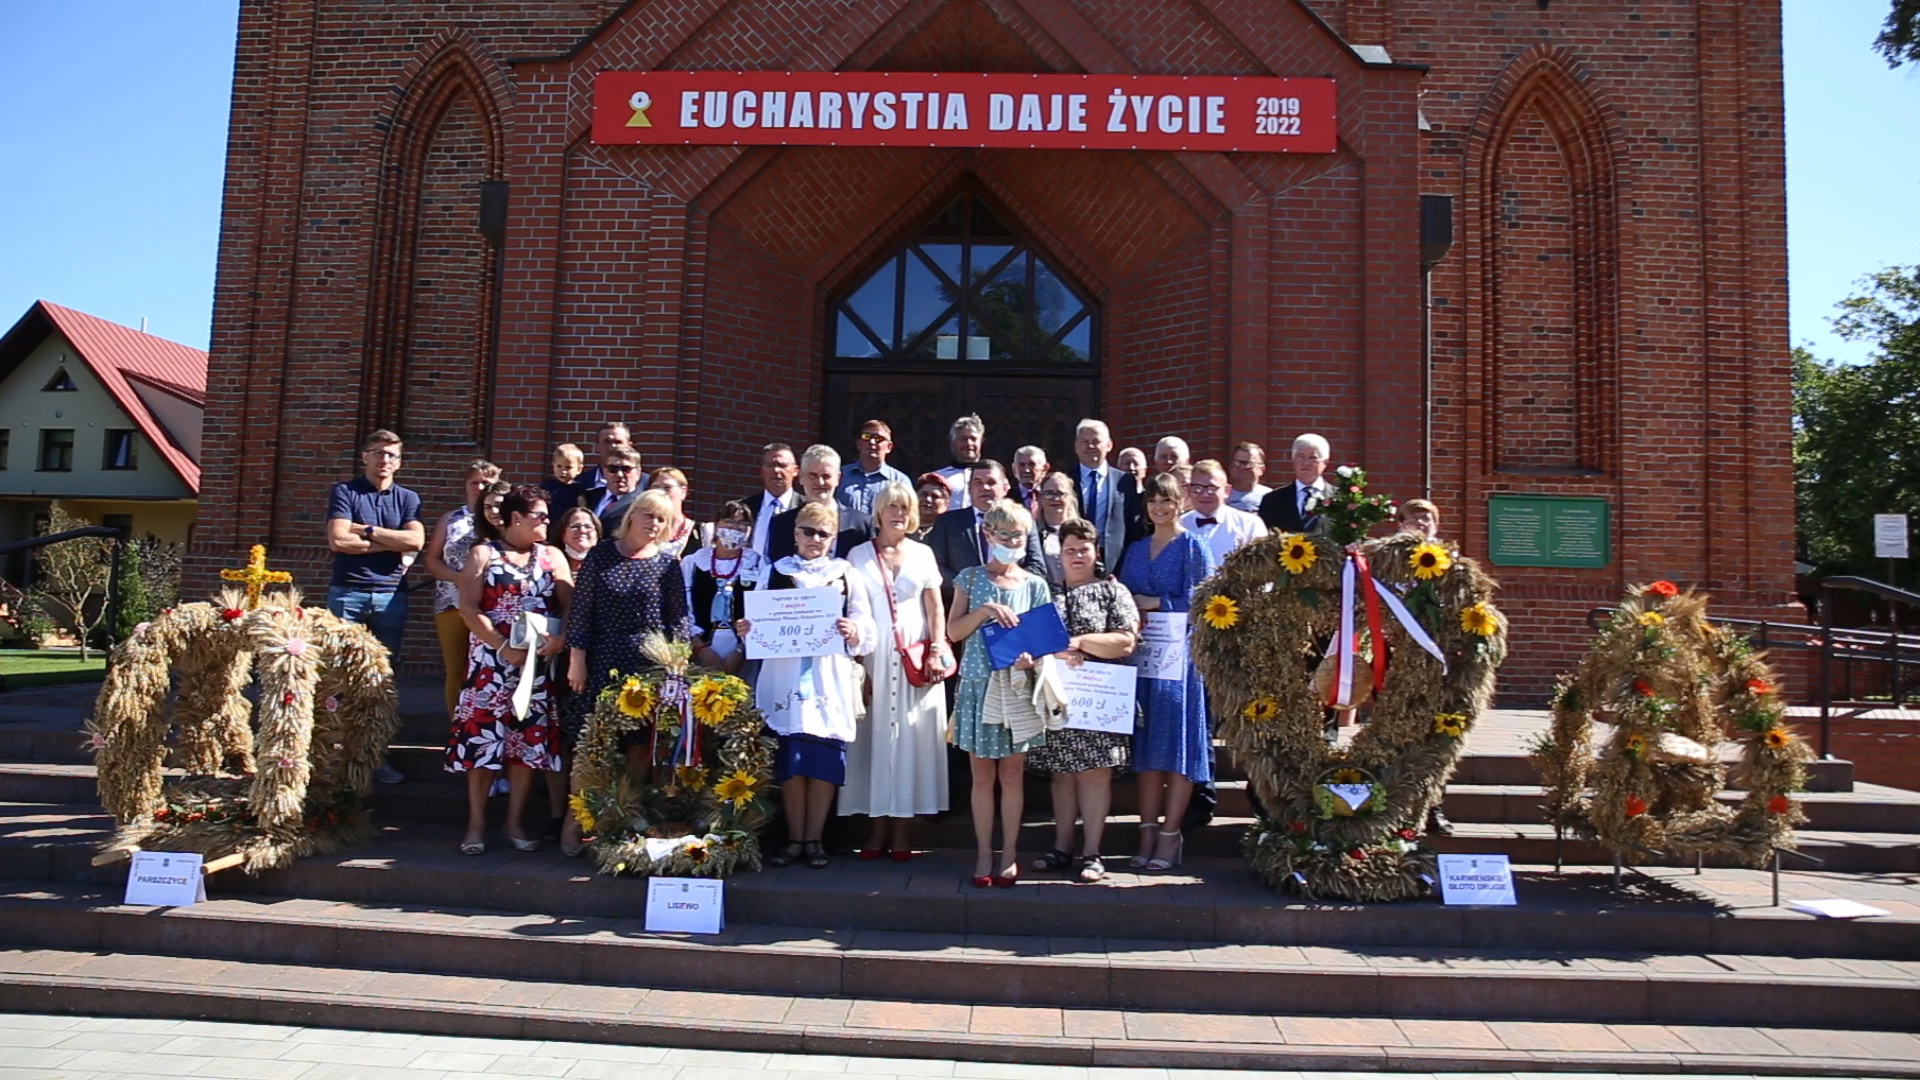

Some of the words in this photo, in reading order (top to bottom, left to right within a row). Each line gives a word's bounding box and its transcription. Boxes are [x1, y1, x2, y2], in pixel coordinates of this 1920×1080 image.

[680, 90, 968, 130] EUCHARYSTIA
[988, 93, 1088, 132] DAJE
[1106, 88, 1226, 134] ŻYCIE
[1255, 97, 1300, 116] 2019
[1255, 116, 1301, 136] 2022
[778, 624, 802, 637] 800
[803, 623, 815, 636] zł
[1071, 696, 1094, 708] 600
[1095, 698, 1107, 710] zł
[667, 901, 700, 910] LISEWO
